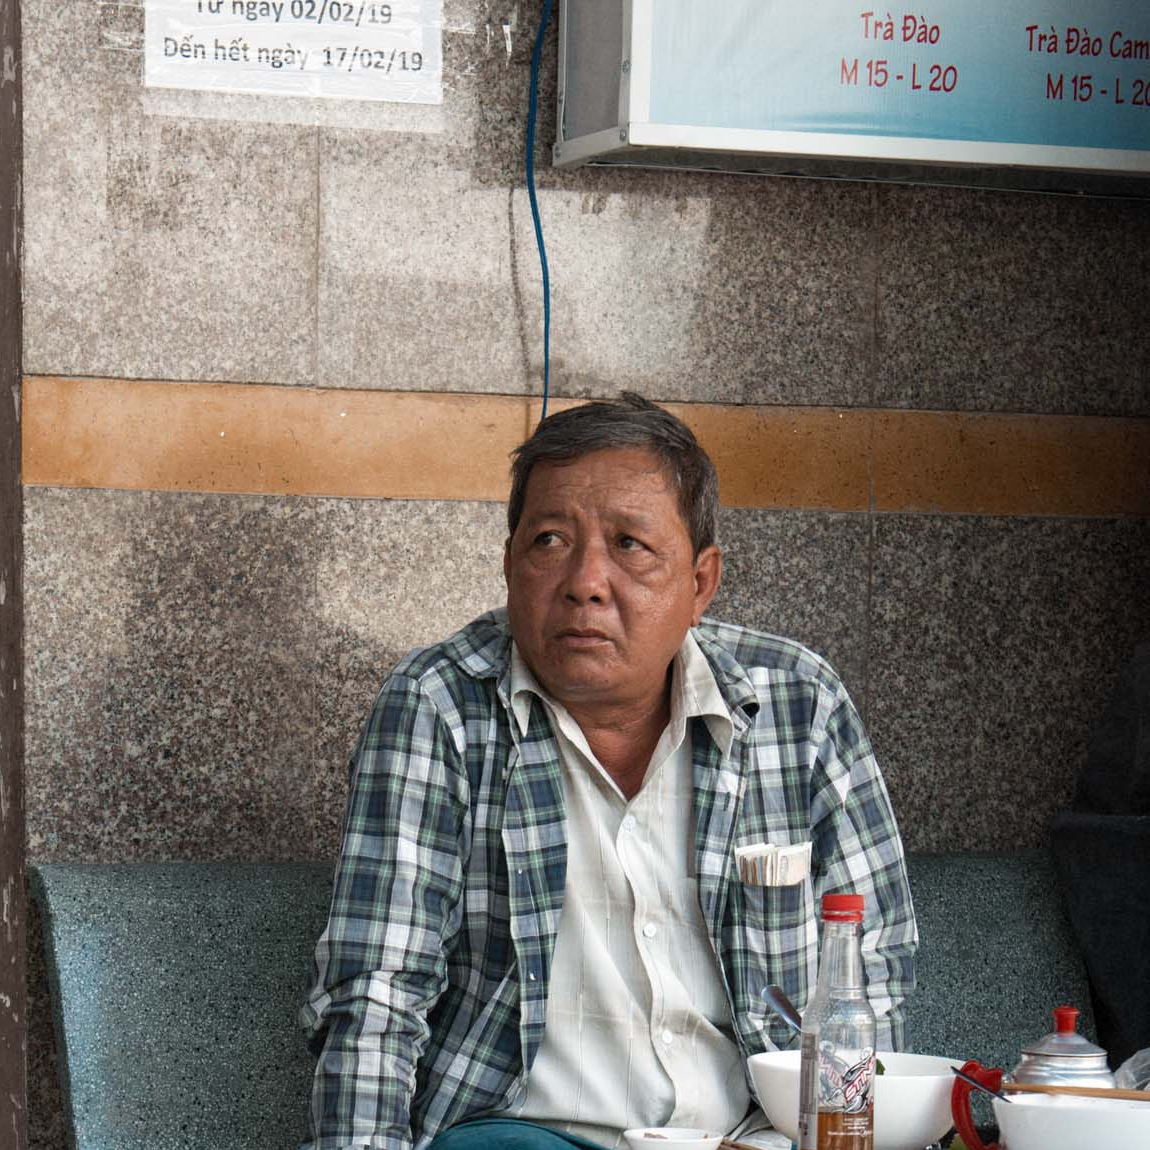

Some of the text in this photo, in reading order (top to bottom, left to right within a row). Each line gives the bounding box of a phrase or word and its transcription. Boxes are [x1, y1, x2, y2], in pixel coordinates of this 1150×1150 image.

[290, 0, 393, 27] 02/02/19
[861, 11, 940, 44] Trà Đào
[214, 38, 250, 62] hết
[257, 43, 309, 70] ngày
[322, 46, 423, 73] 17/02/19
[1026, 25, 1150, 60] Trà Đào Cam
[840, 58, 859, 86] M
[866, 59, 888, 88] 15
[911, 64, 922, 90] L
[929, 65, 958, 93] 20
[1046, 73, 1064, 100] M
[1071, 75, 1093, 102] 15
[1115, 78, 1125, 104] L
